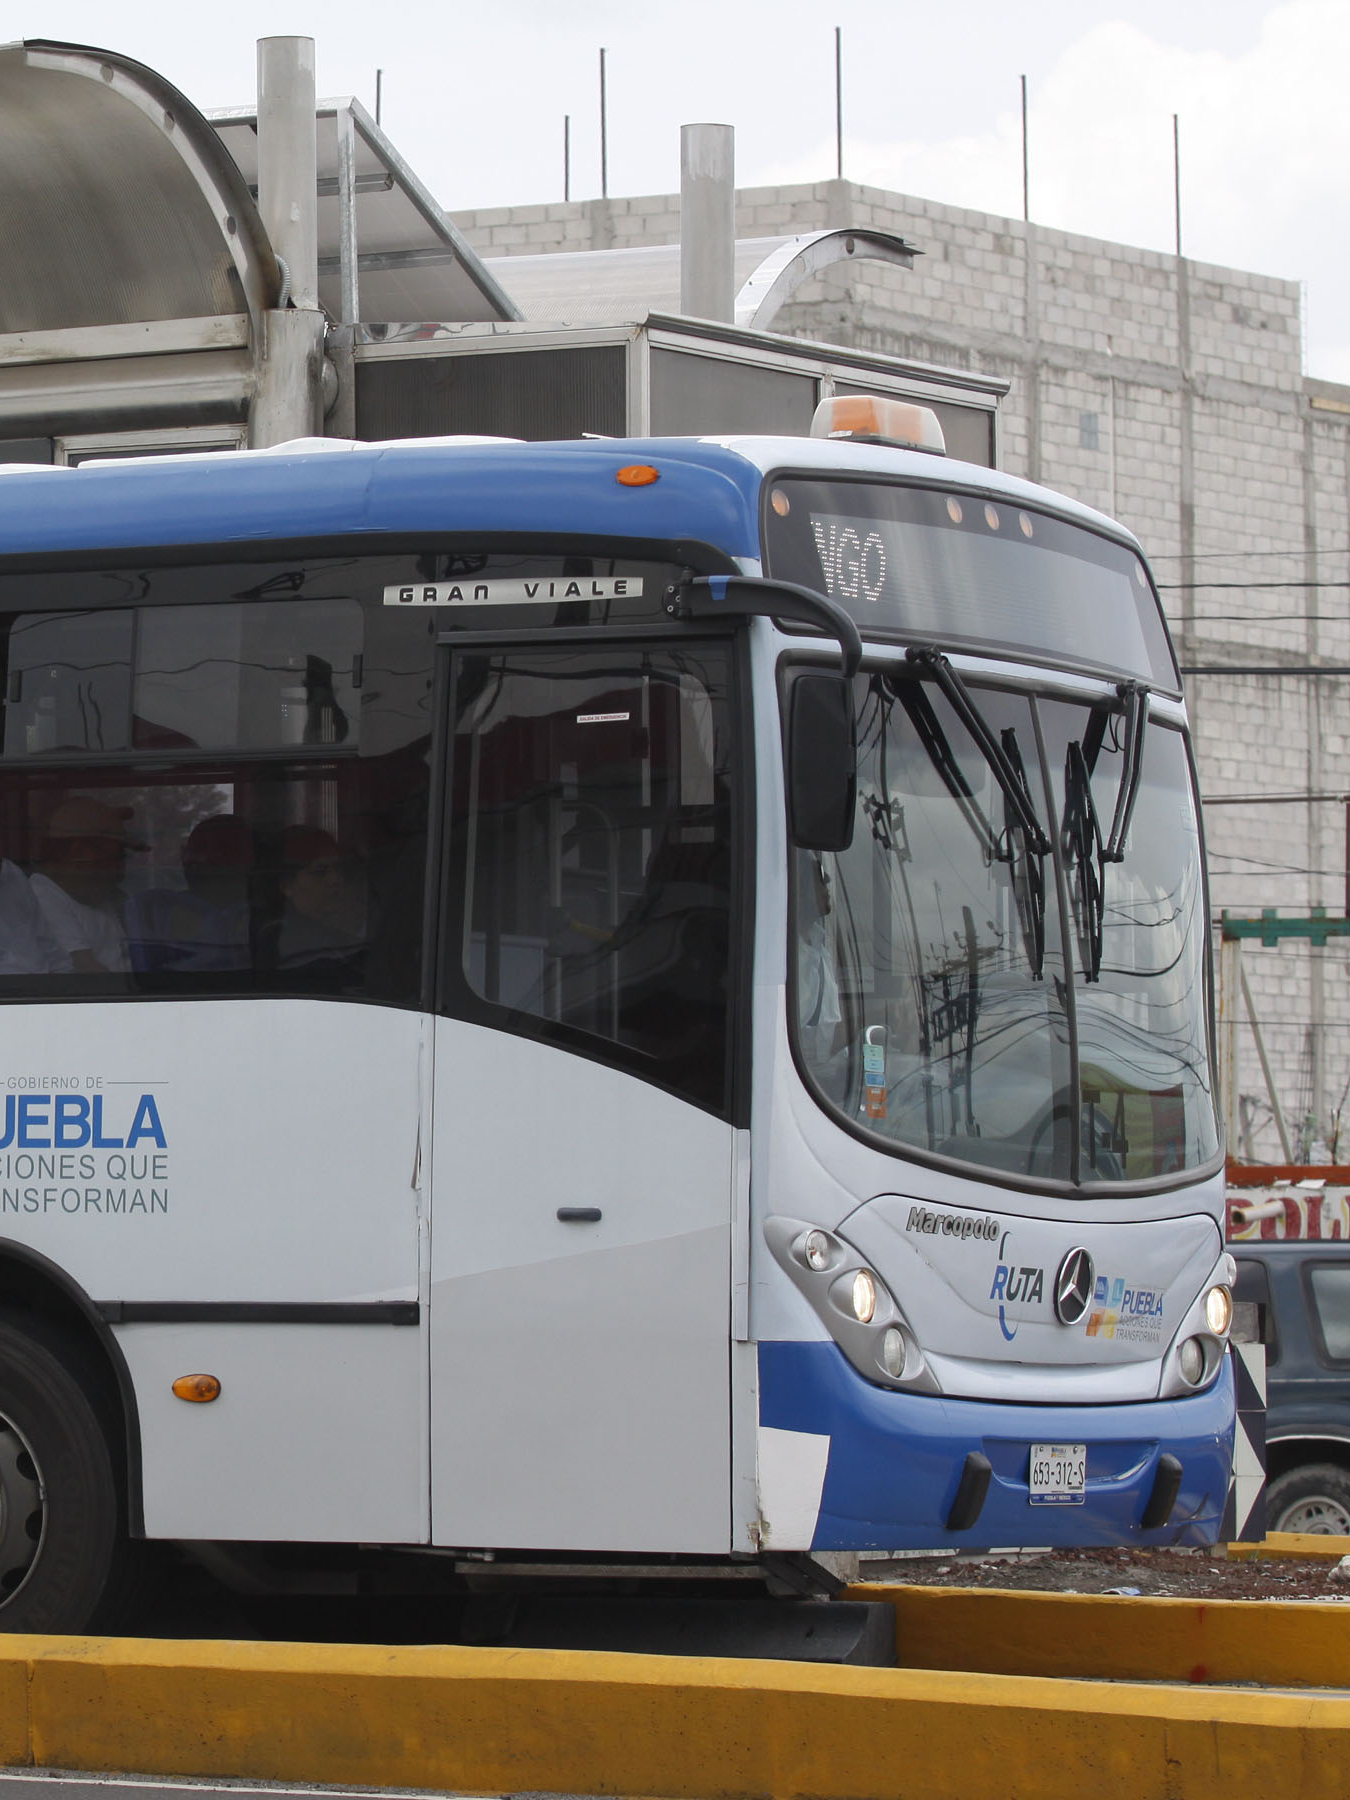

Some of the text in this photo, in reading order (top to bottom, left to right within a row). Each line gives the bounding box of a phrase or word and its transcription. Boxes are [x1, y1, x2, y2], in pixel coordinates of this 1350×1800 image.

[399, 579, 628, 603] GRAN VIALE
[7, 1076, 103, 1089] GOBIERNO DE
[106, 1153, 169, 1182] QUE
[905, 1206, 1000, 1242] Marcopolo
[989, 1264, 1044, 1304] RUTA
[1121, 1289, 1163, 1317] PUEBLA
[1033, 1460, 1085, 1486] 653-312-S
